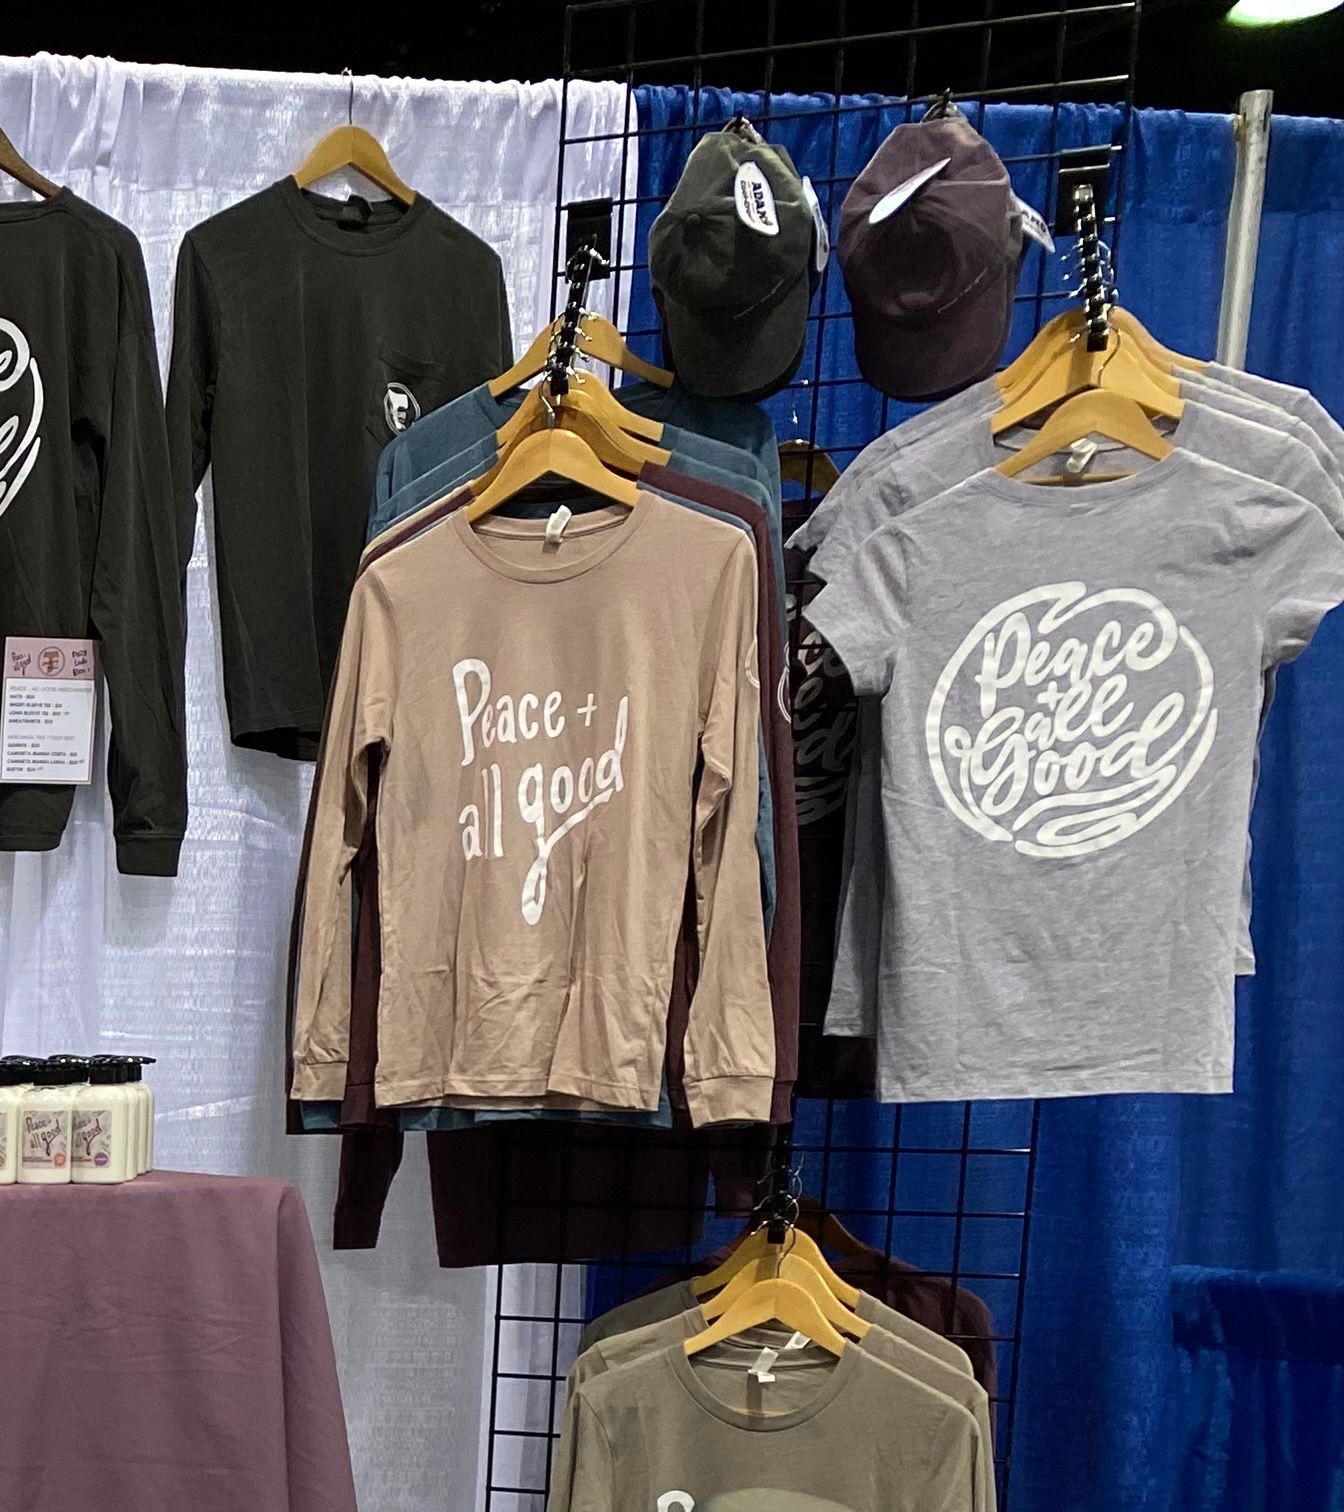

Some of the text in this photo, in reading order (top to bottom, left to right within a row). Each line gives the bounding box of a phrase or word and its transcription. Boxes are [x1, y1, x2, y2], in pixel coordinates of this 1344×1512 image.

[453, 658, 565, 766] Peace
[974, 612, 1170, 719] Peace
[459, 696, 628, 925] all good
